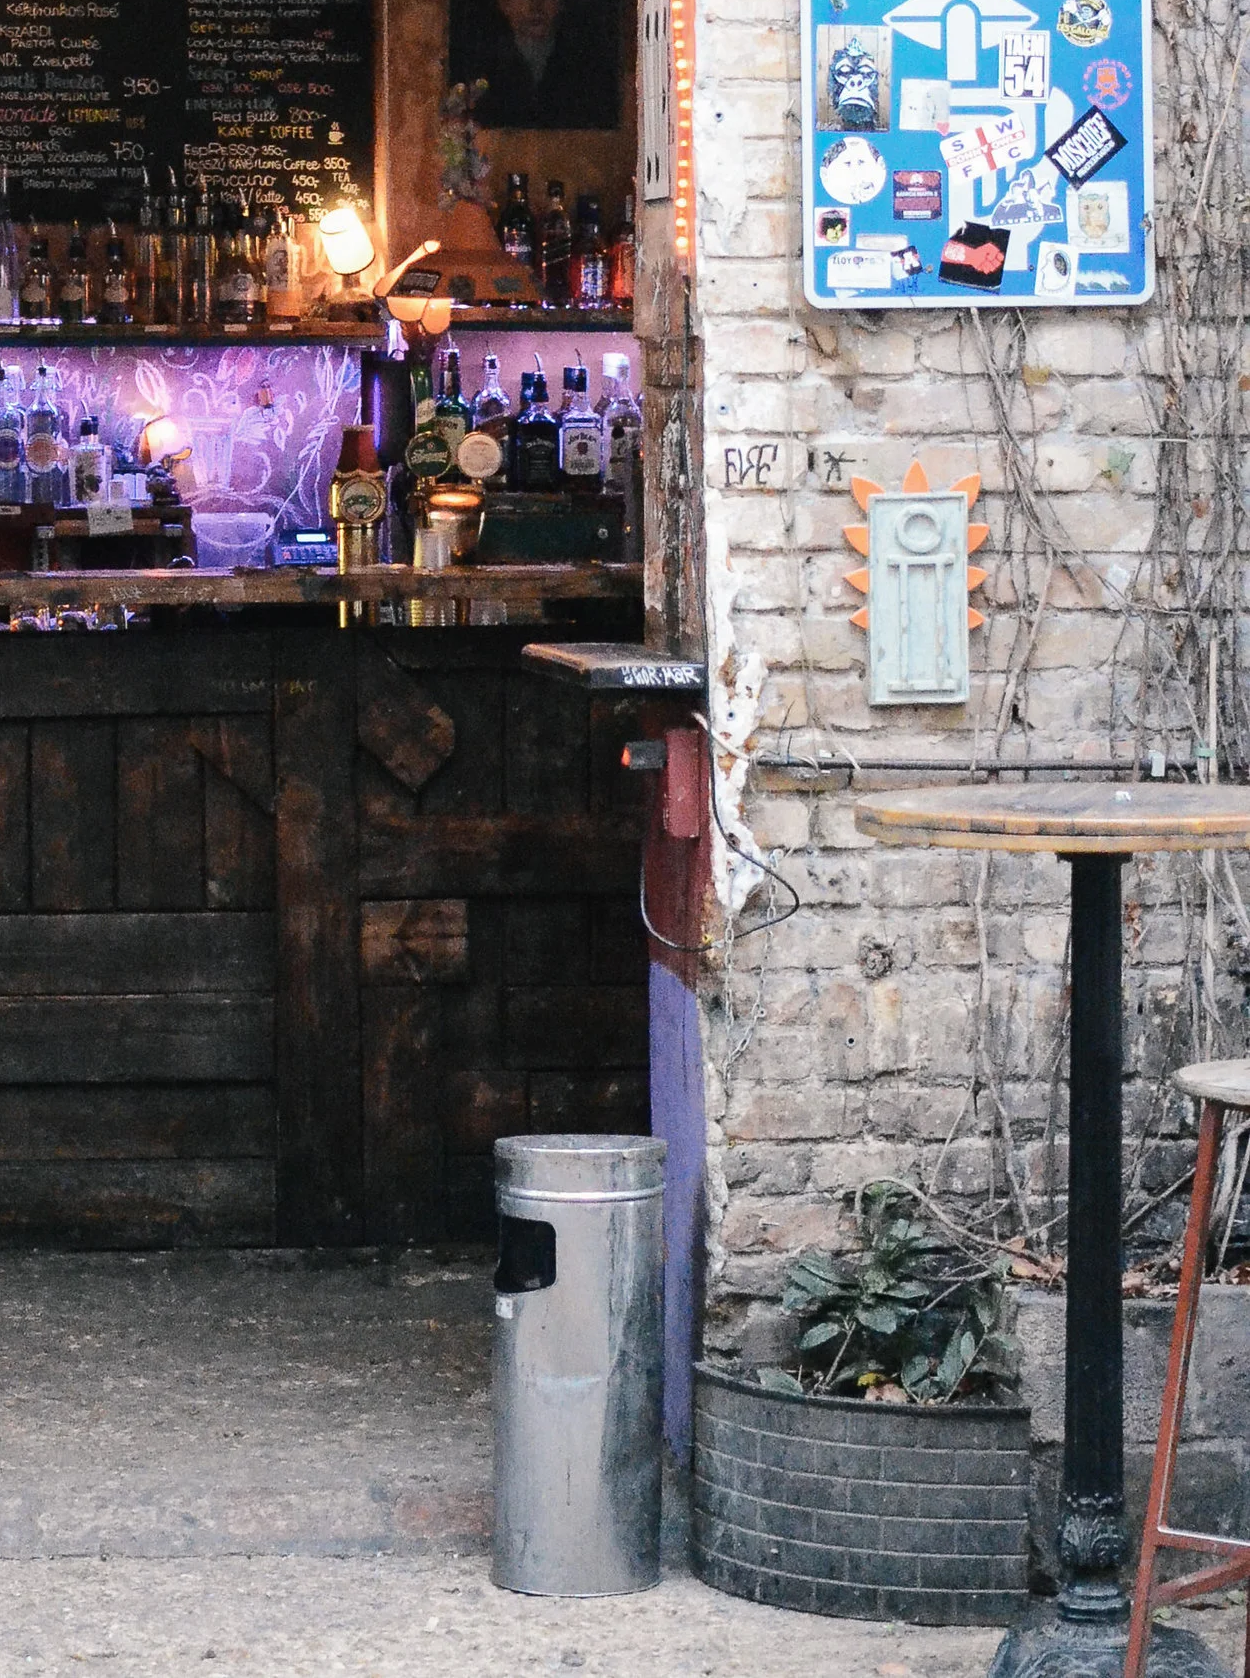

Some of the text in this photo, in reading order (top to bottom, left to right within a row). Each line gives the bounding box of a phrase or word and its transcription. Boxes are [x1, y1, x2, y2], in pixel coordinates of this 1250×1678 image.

[1004, 34, 1045, 57] TAEM
[1004, 56, 1045, 98] 54
[270, 124, 315, 140] COFFEE
[995, 119, 1013, 134] W
[1008, 146, 1021, 159] C
[1052, 112, 1112, 177] MISCHIEF
[332, 172, 351, 183] TEA
